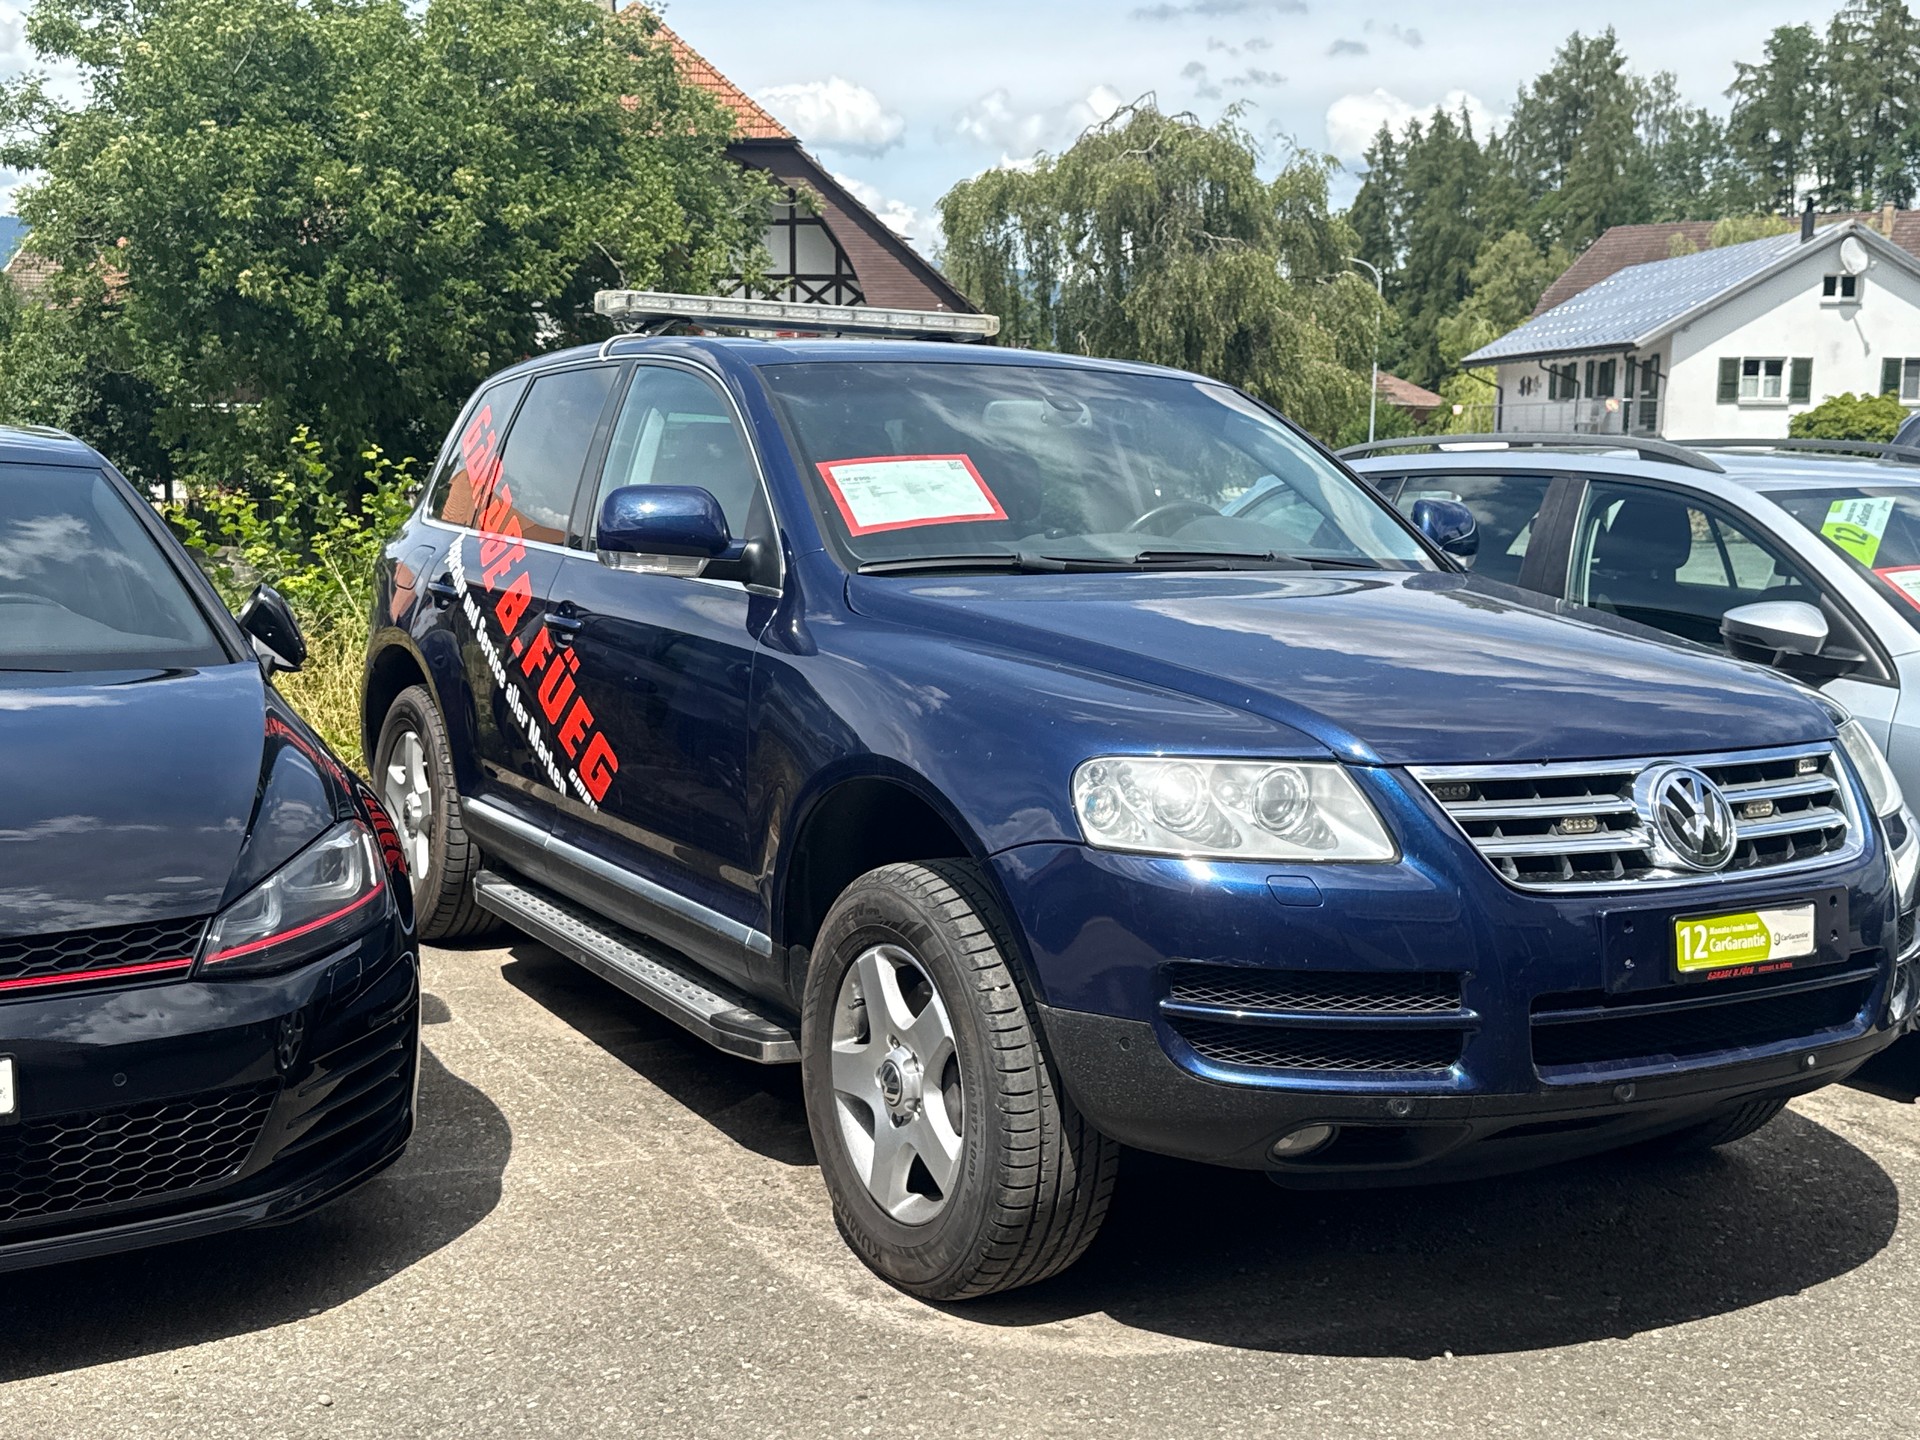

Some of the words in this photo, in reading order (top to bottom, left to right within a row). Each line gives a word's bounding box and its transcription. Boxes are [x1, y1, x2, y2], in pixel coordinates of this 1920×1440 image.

[462, 405, 527, 593] GARAGE
[1833, 526, 1869, 546] 12
[463, 592, 481, 630] und
[476, 616, 507, 690] Service
[505, 682, 529, 729] aller
[528, 716, 567, 797] Marken
[1679, 924, 1709, 961] 12
[1709, 932, 1767, 953] CarGarantie
